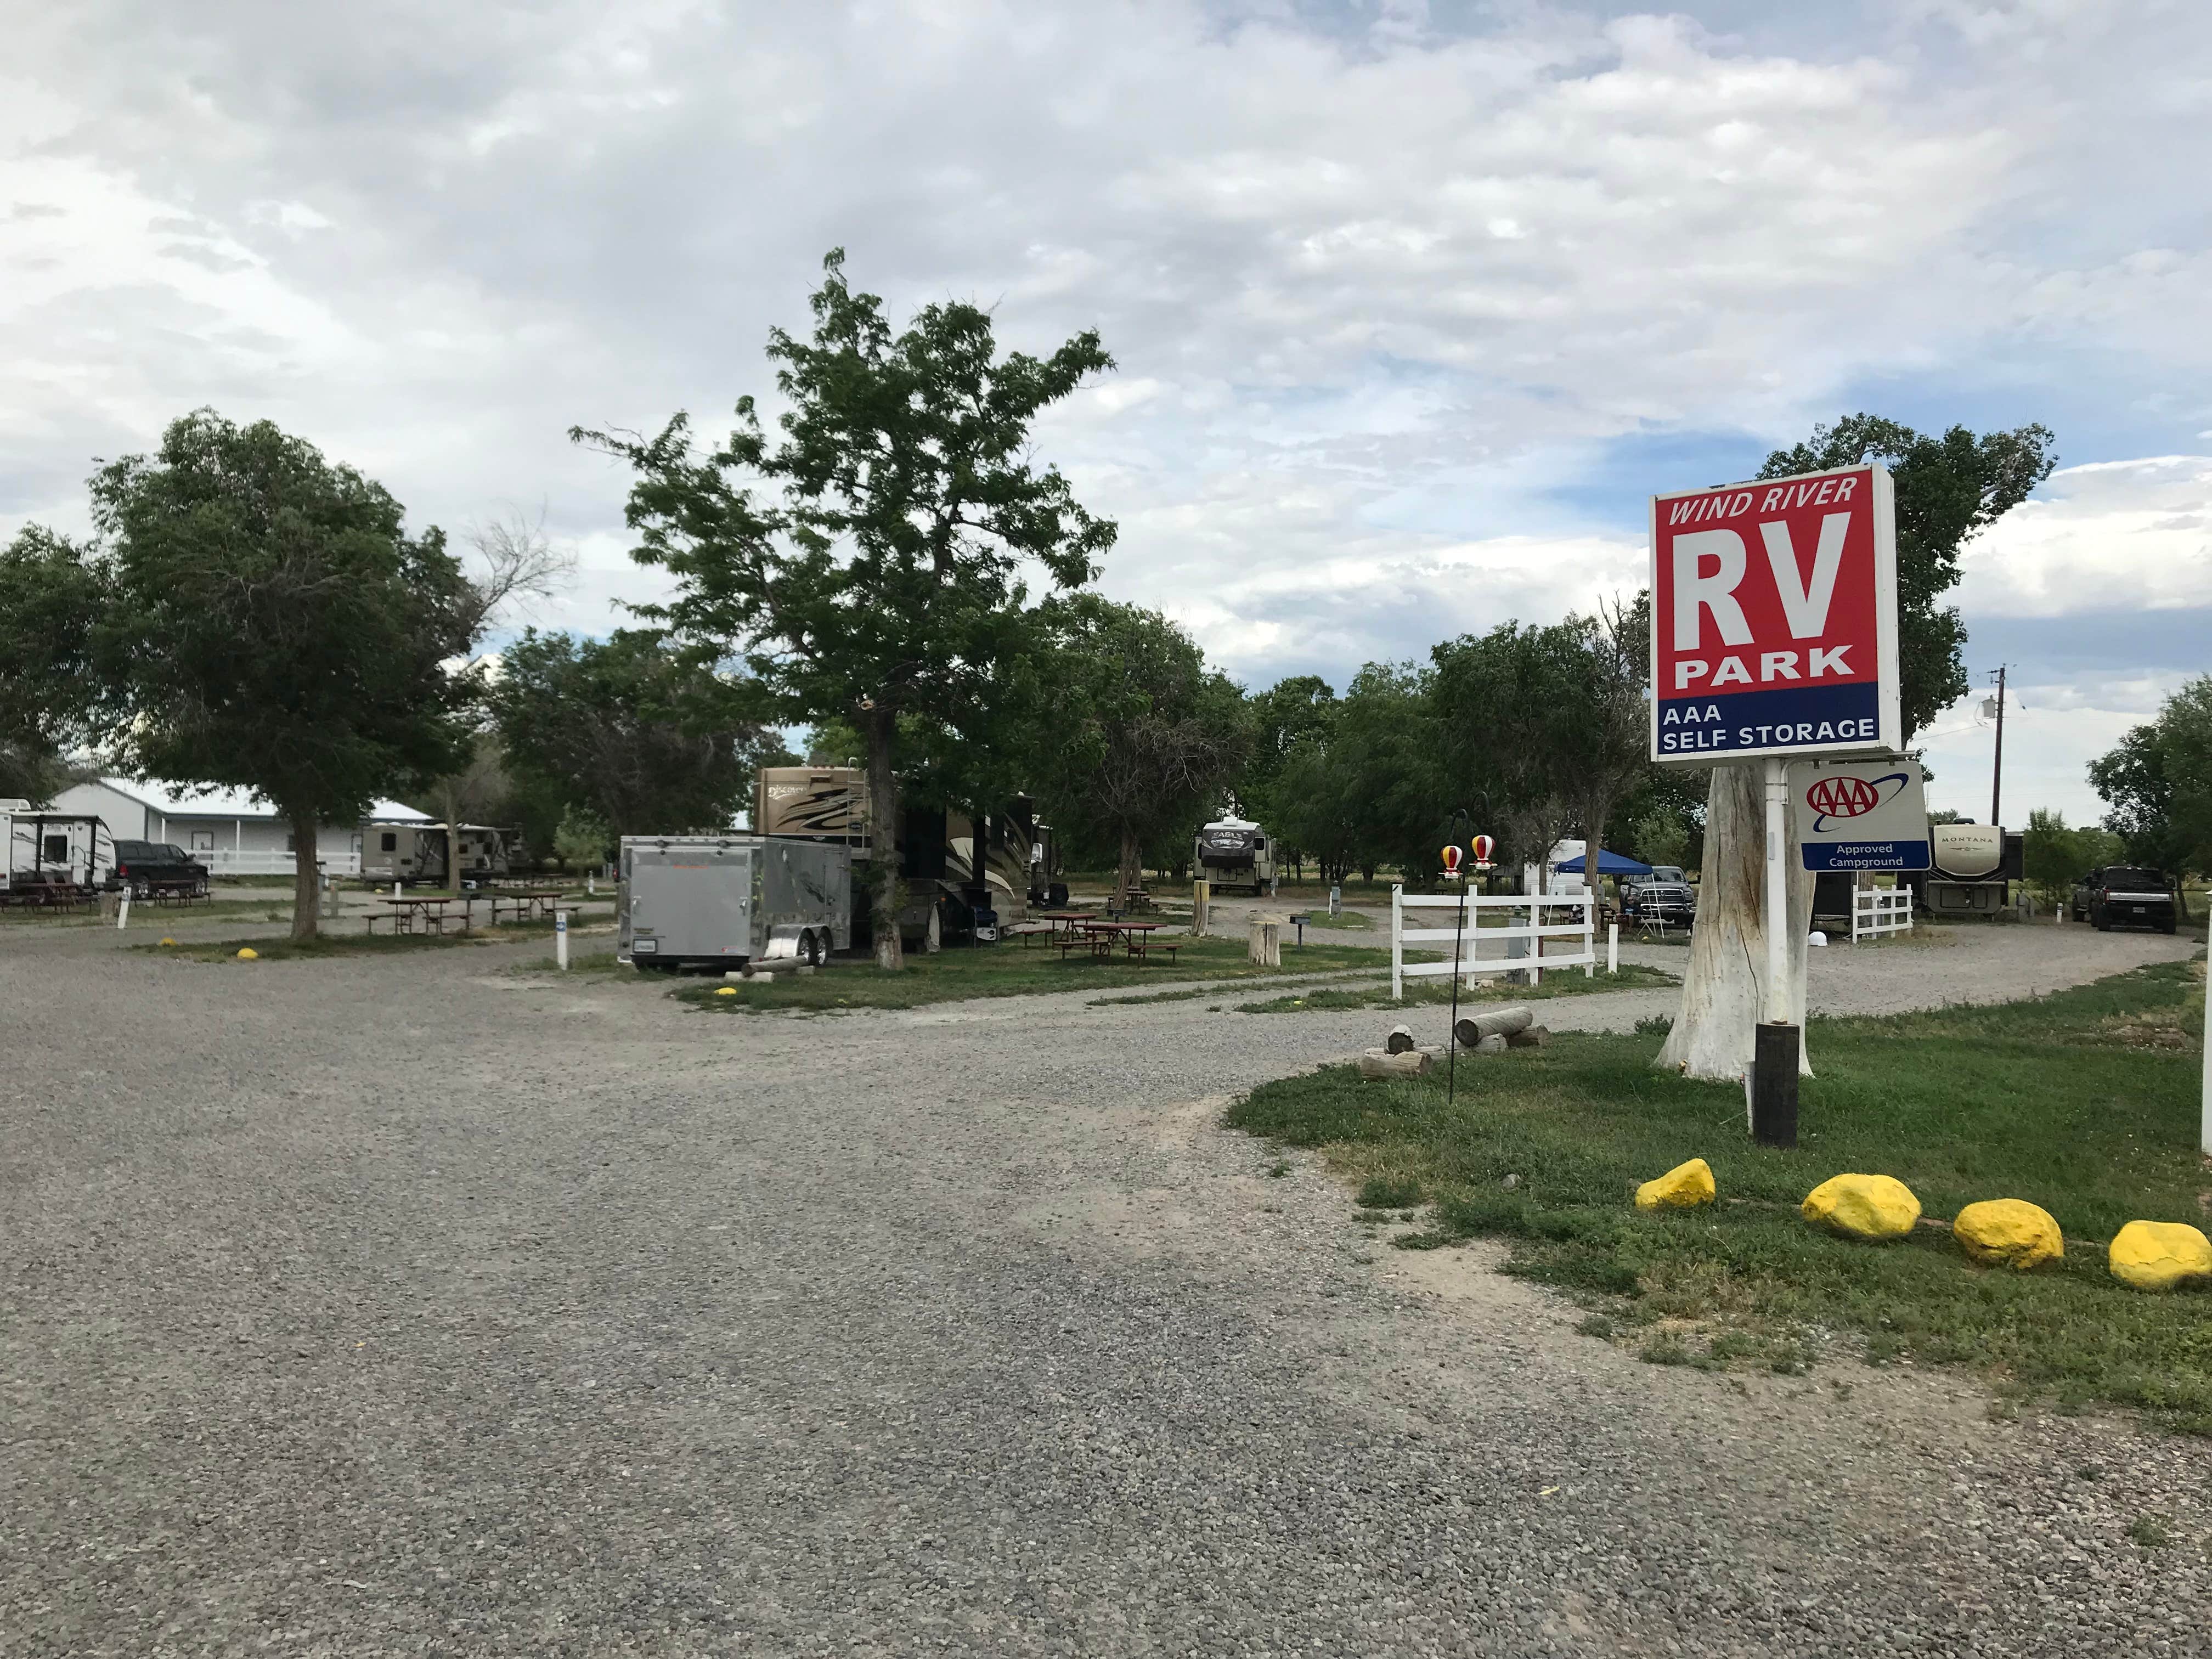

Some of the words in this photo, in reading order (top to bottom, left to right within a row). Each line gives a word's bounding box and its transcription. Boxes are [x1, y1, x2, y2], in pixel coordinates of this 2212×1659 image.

[1669, 492, 1753, 526] WIND
[1759, 477, 1858, 513] RIVER
[1672, 511, 1852, 652] RV
[1674, 645, 1855, 690] PARK
[1662, 704, 1722, 726] AAA
[1663, 729, 1726, 751] SELF
[1739, 718, 1875, 746] STORAGE
[1815, 777, 1872, 817] AAA
[1211, 832, 1243, 840] EAGLE
[1837, 843, 1893, 856] Approved
[1829, 856, 1904, 868] Campground
